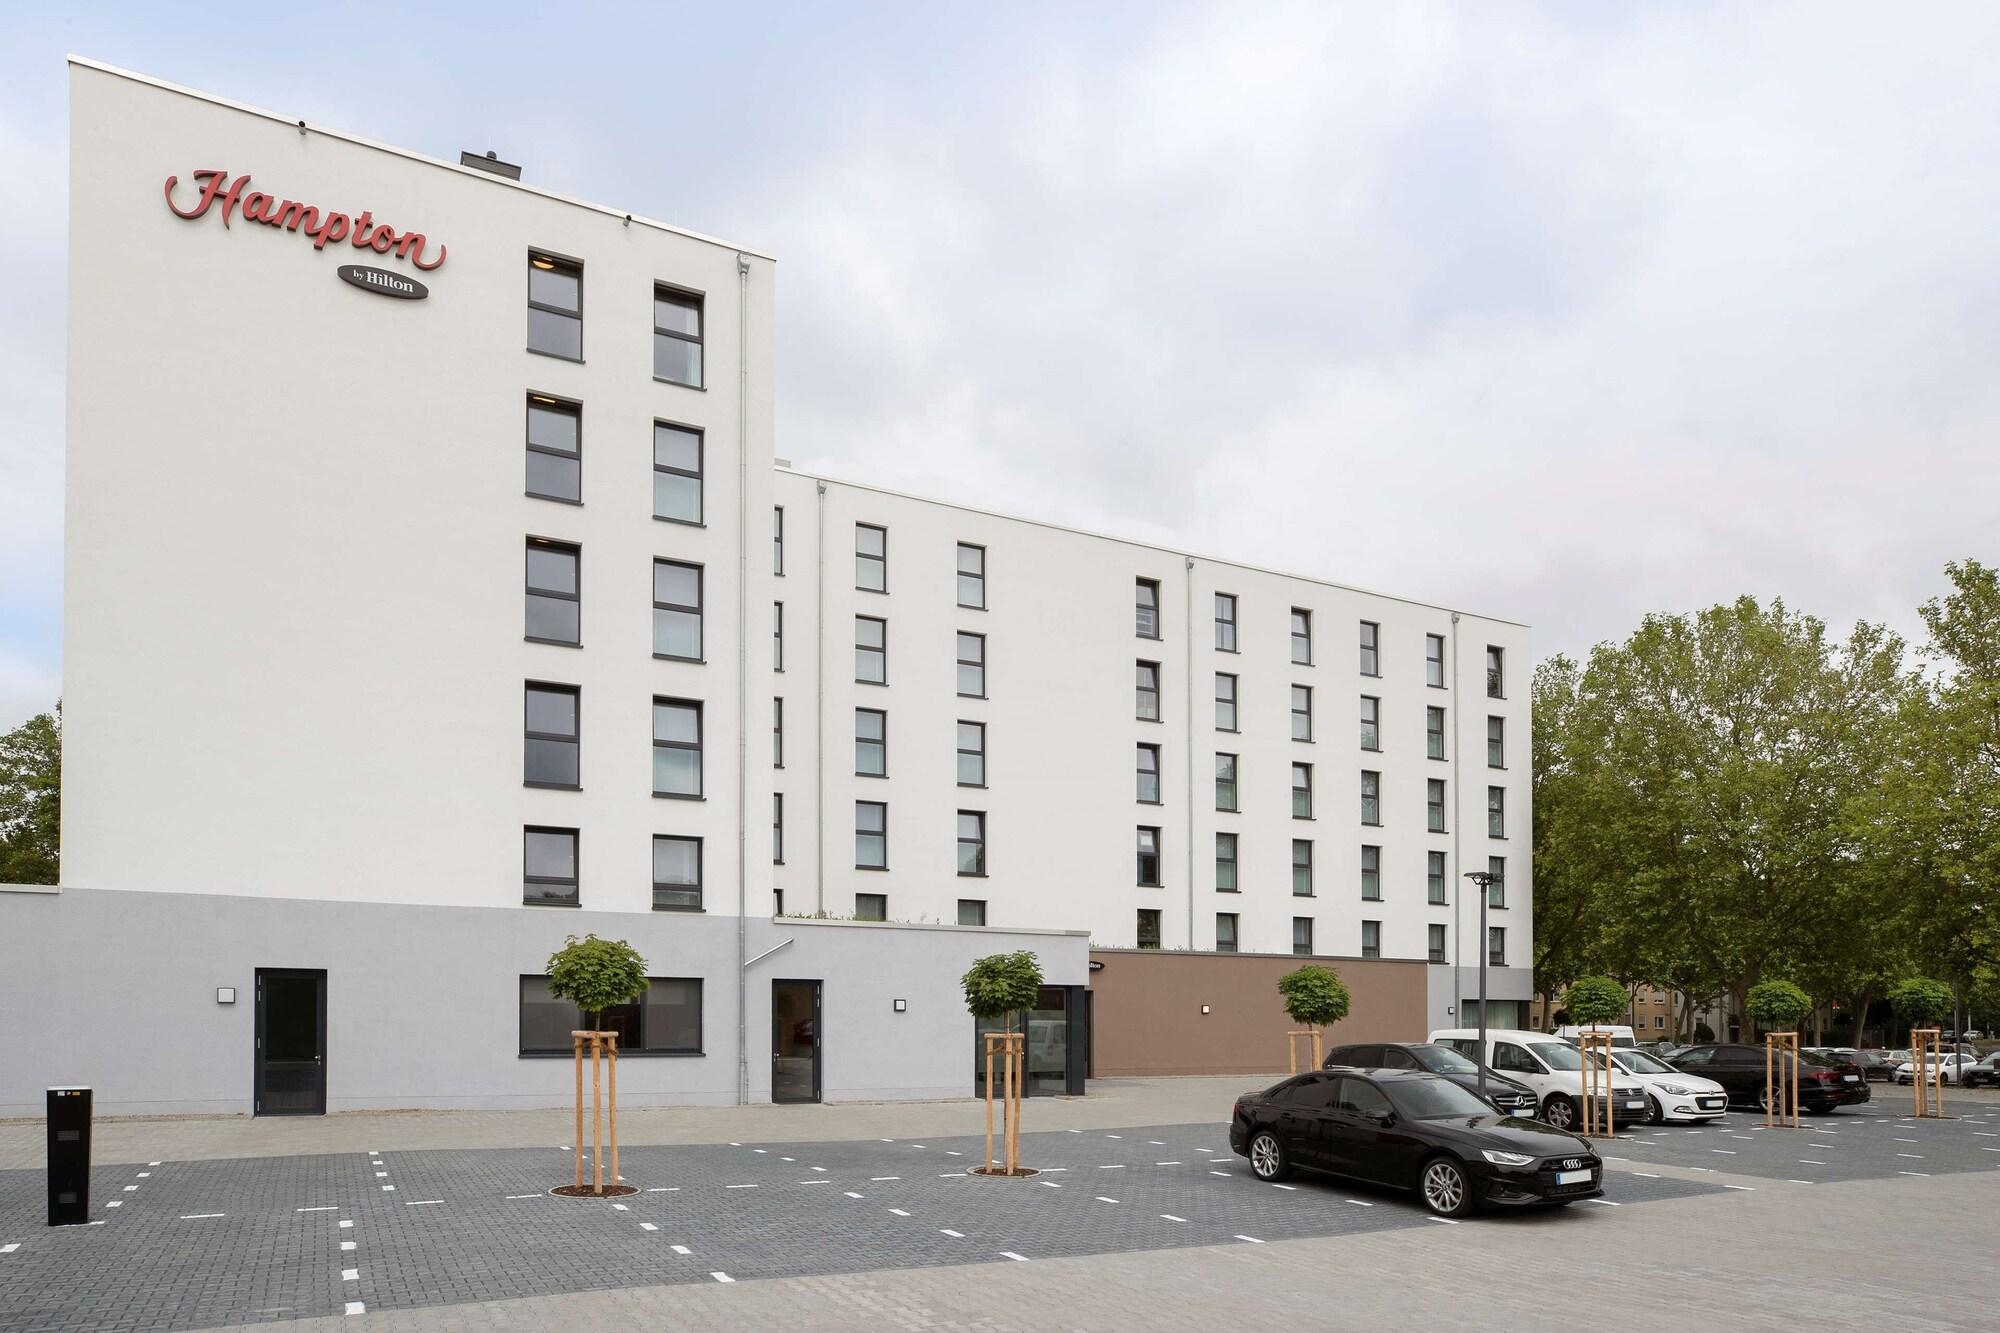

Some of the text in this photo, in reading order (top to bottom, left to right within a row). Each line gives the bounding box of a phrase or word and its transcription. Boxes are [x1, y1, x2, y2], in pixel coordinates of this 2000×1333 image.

[165, 170, 446, 270] Hampton
[353, 269, 414, 293] by Hilton
